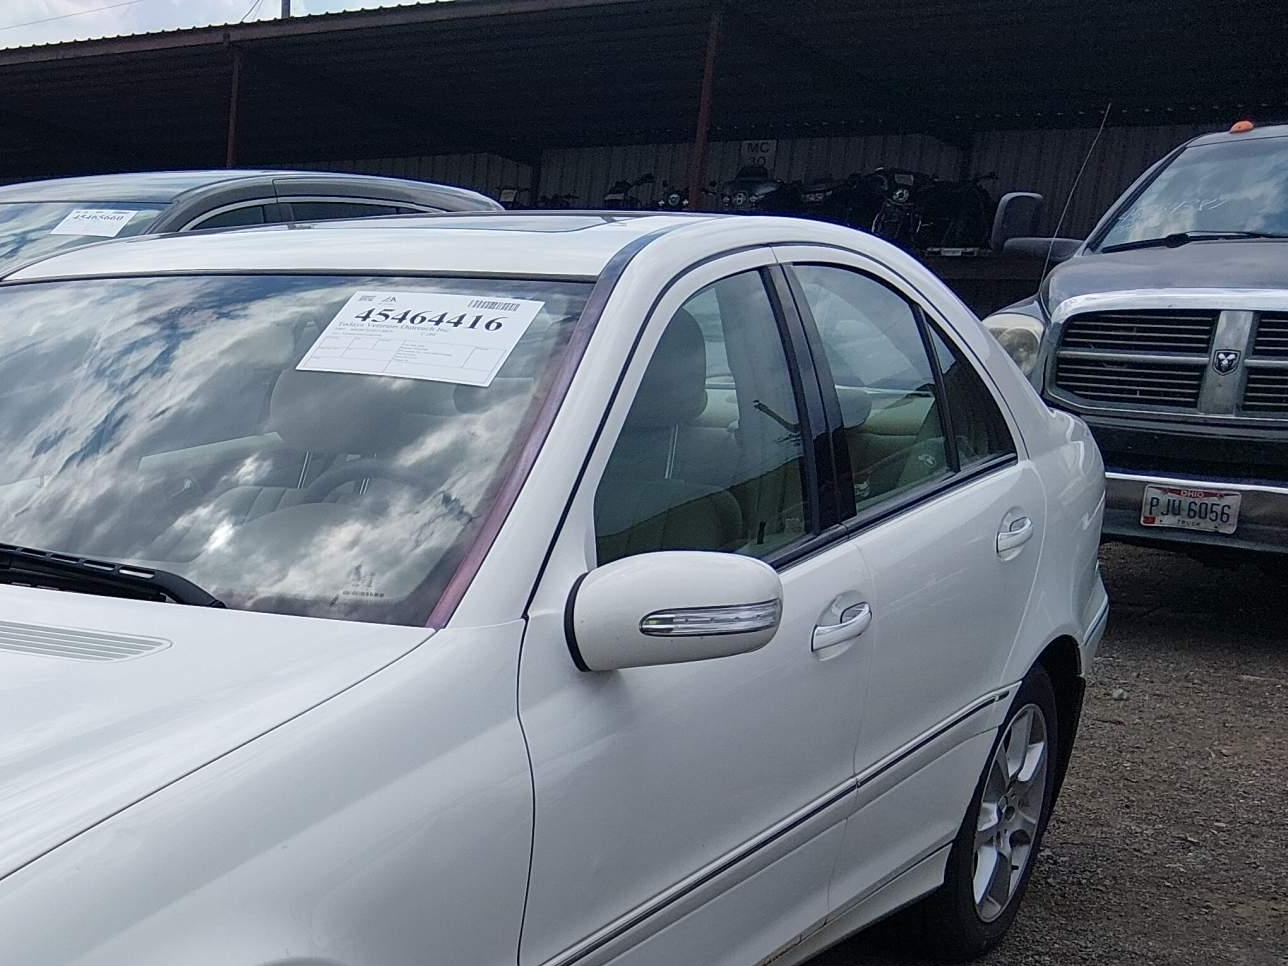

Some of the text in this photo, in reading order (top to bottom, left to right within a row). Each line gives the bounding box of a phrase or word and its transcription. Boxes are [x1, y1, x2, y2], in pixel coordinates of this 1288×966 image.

[354, 307, 509, 332] 45464416
[1180, 490, 1205, 498] OHIO
[1187, 501, 1231, 523] 6056
